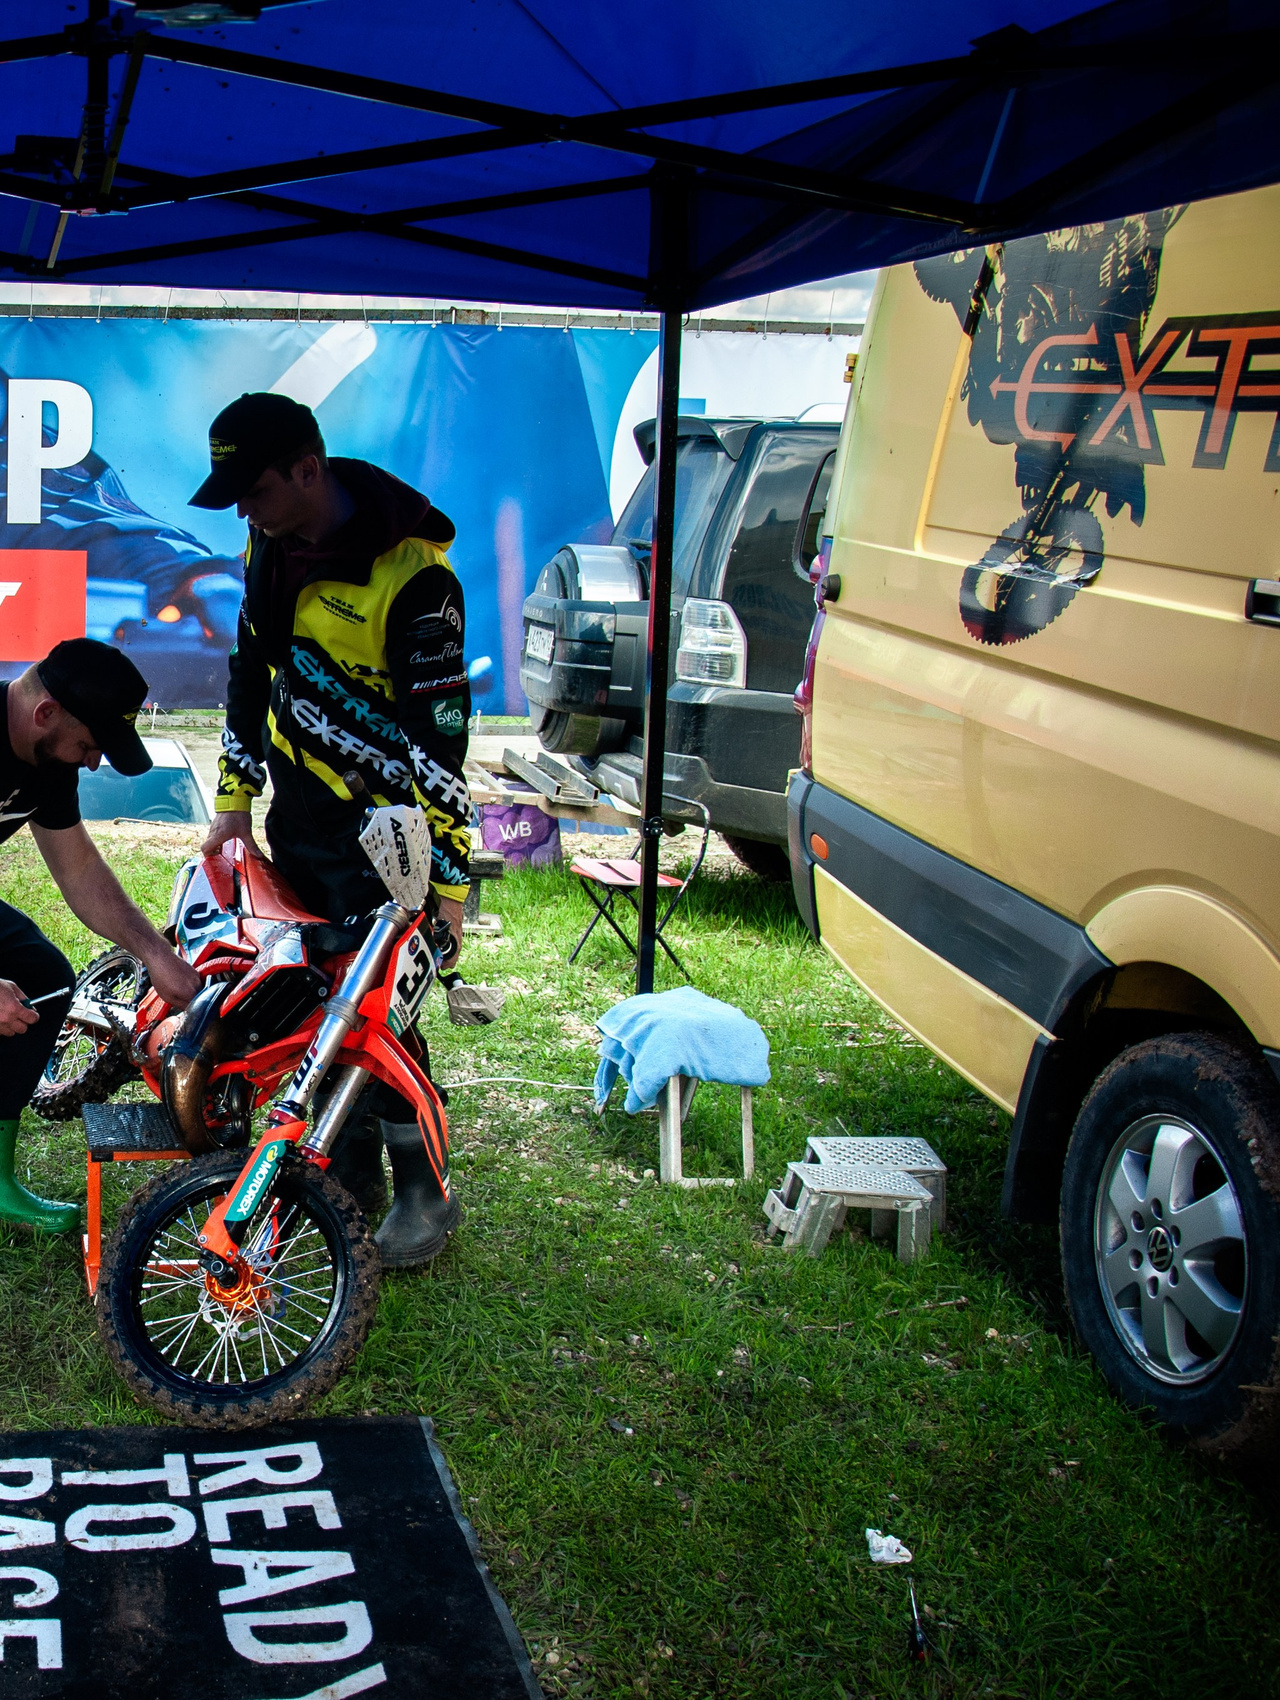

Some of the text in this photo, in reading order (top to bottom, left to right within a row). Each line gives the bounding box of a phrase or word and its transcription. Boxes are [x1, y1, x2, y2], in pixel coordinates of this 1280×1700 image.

[988, 322, 1280, 456] EXT
[291, 645, 408, 745] EXTREM
[435, 708, 462, 725] БИО
[499, 821, 532, 842] WB
[236, 1160, 272, 1216] MOTOREX
[61, 1453, 200, 1552] TO
